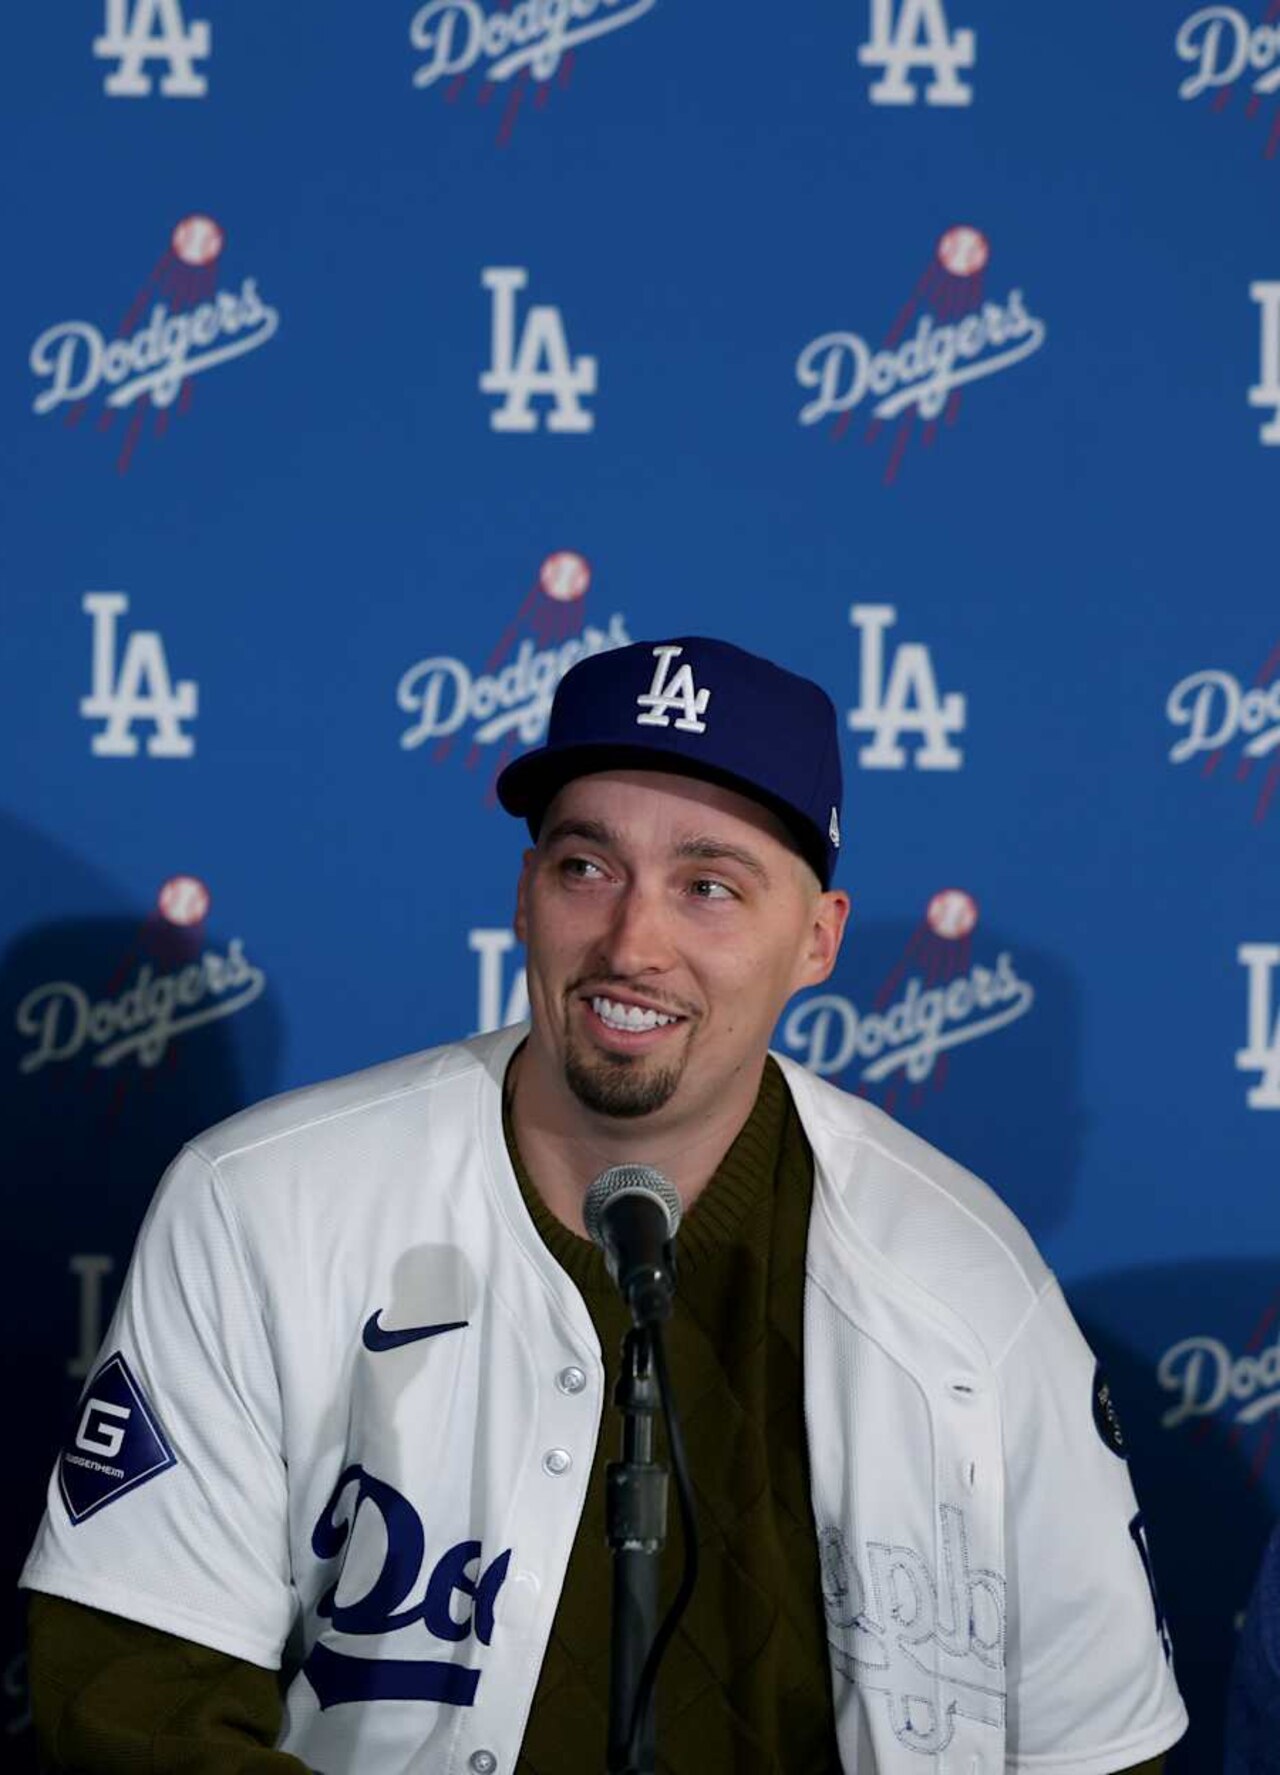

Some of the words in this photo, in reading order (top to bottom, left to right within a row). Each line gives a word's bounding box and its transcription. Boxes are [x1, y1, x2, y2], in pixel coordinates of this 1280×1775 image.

[29, 276, 280, 414] Dodgers
[478, 266, 598, 434] LA
[795, 288, 1046, 427] Dodgers
[79, 591, 199, 759] LA
[635, 644, 712, 735] LA
[846, 603, 967, 771] LA
[16, 940, 265, 1075] Dodgers
[783, 951, 1035, 1083] Dodgers
[75, 1397, 131, 1458] G
